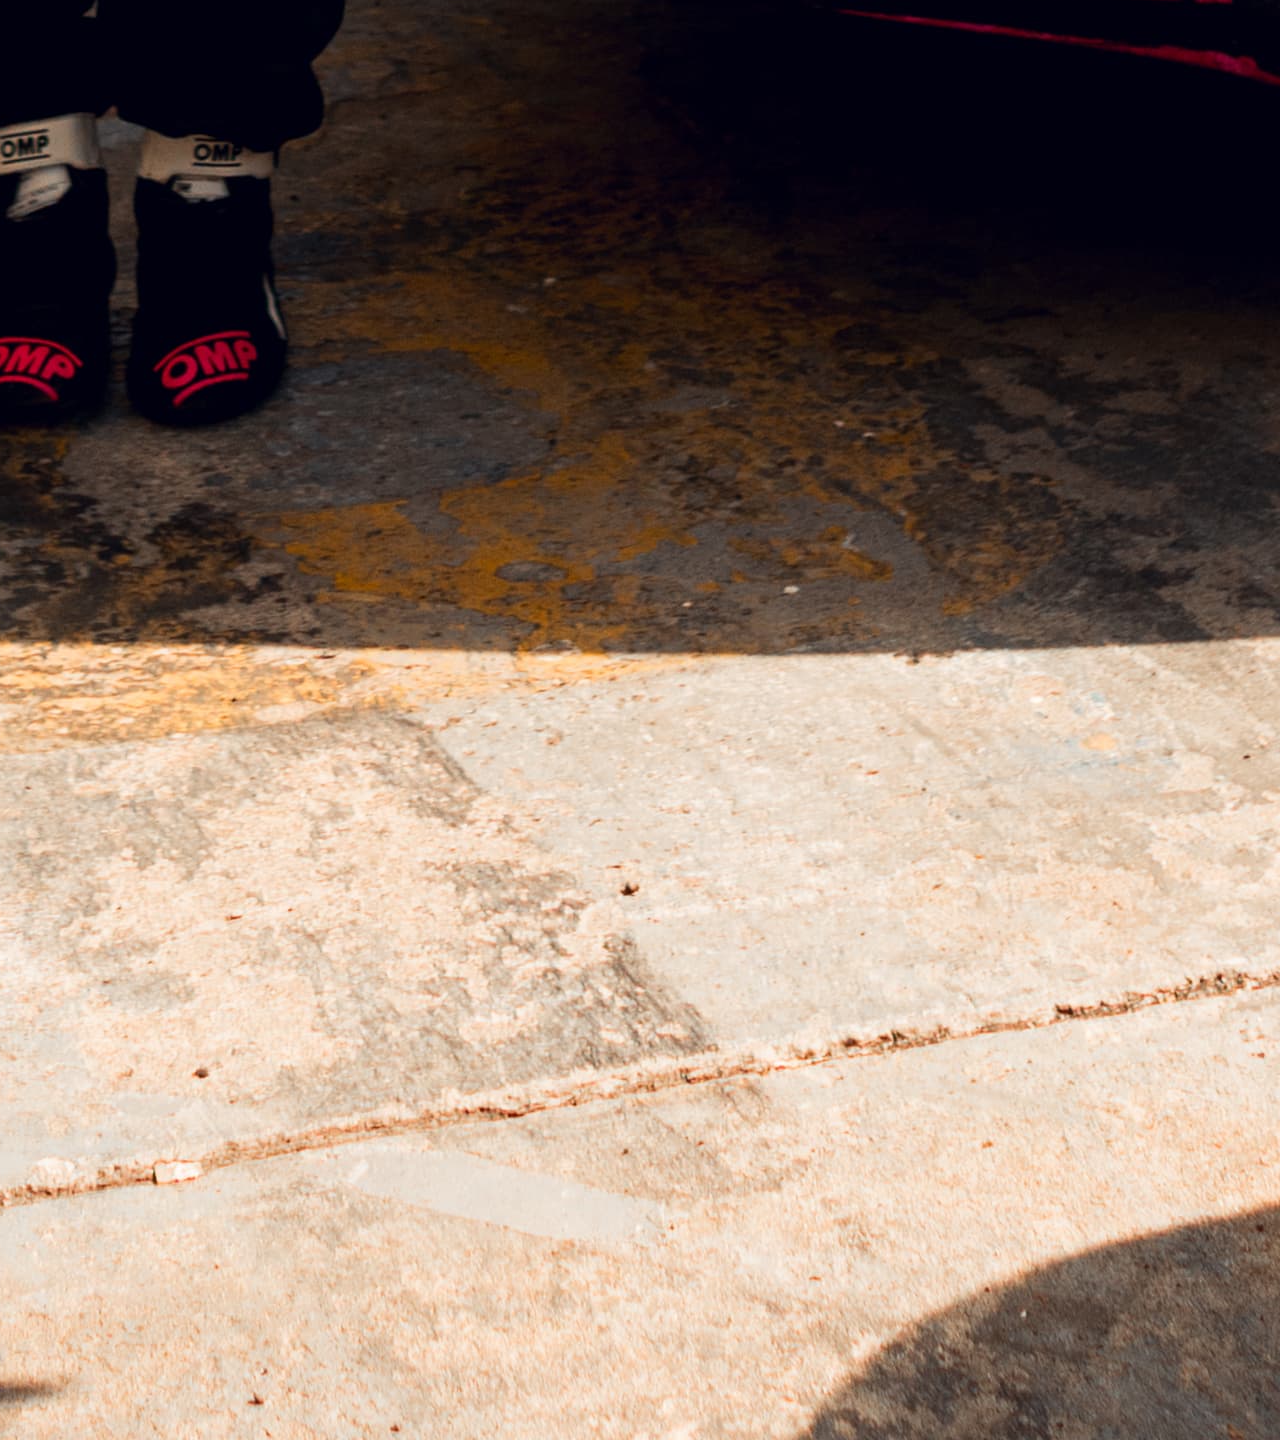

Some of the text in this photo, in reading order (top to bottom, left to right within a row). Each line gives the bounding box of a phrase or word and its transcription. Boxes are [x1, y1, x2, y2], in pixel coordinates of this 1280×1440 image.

[0, 135, 50, 159] OMP
[193, 142, 241, 162] OMP
[161, 340, 258, 389] OMP
